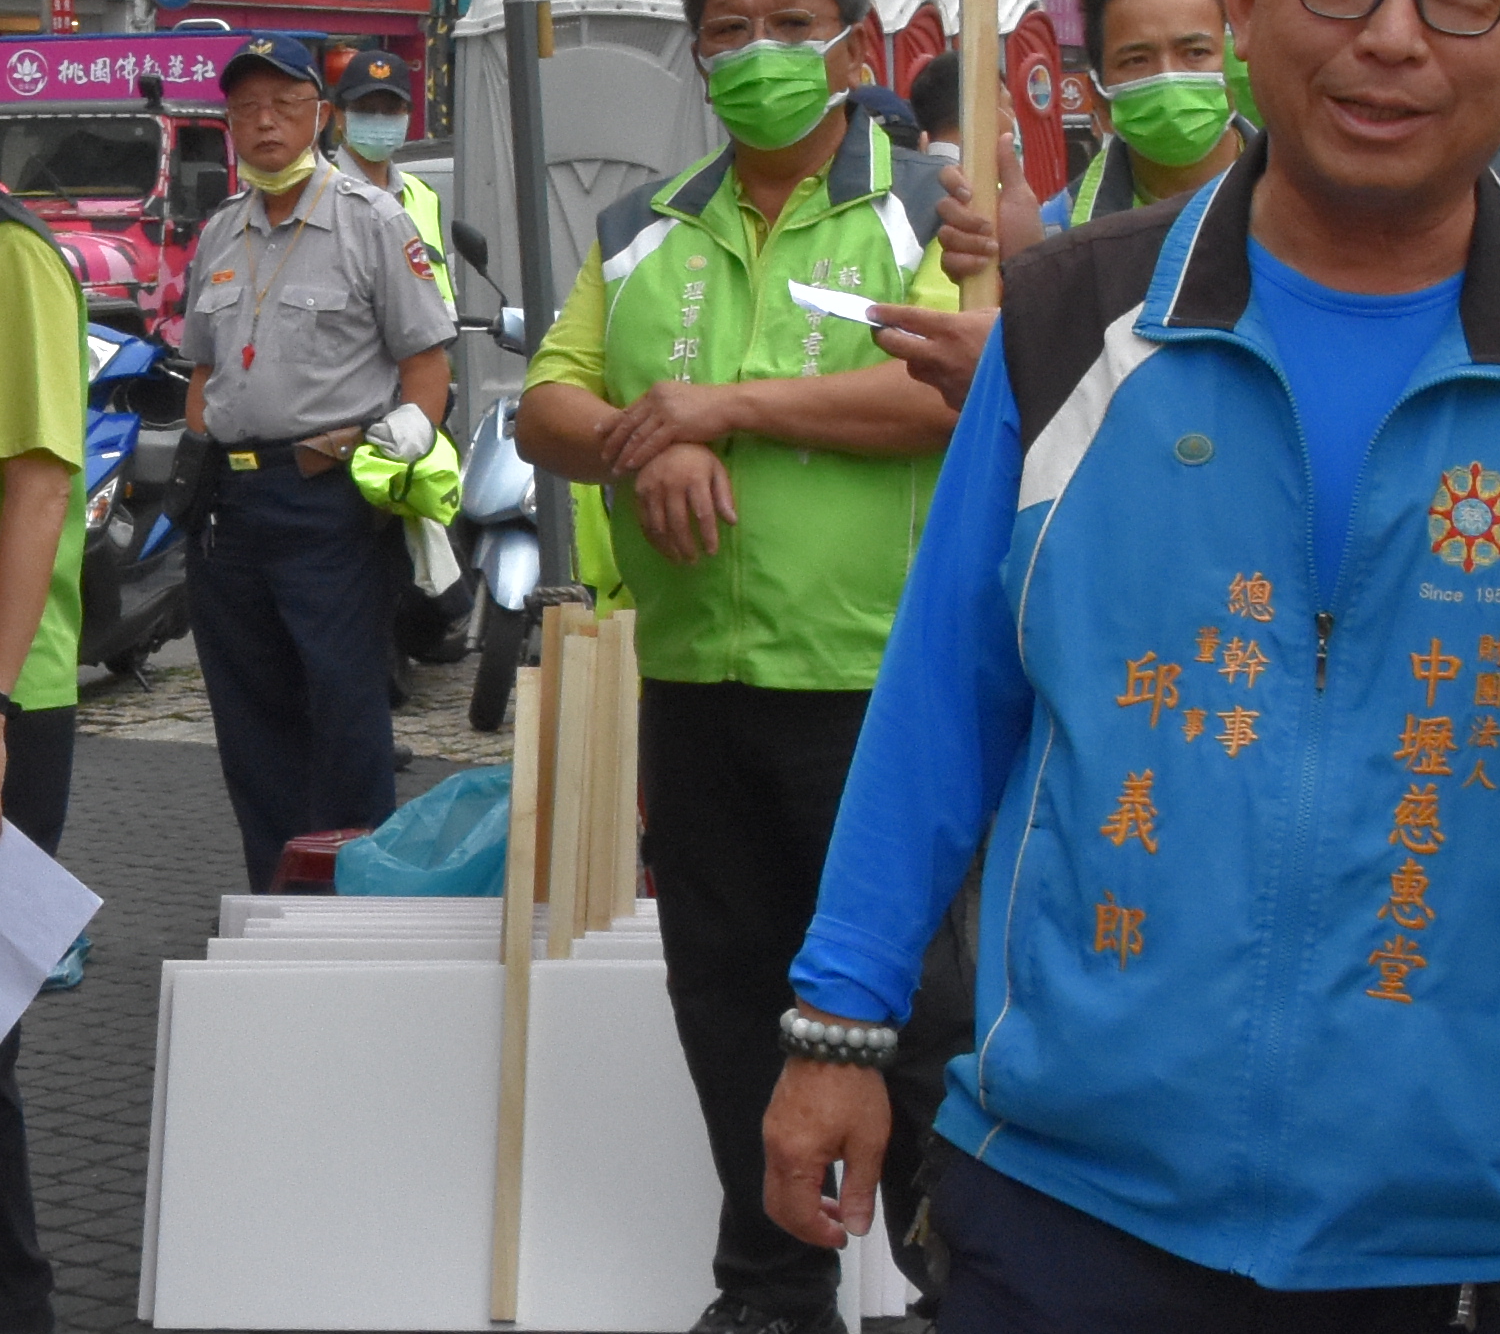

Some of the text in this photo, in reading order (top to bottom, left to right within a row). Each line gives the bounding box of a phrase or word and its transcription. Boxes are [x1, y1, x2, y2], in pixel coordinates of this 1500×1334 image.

[1214, 571, 1276, 758] 總幹事
[1419, 582, 1464, 603] Since
[1092, 650, 1181, 971] 邱義郎
[1366, 637, 1464, 1005] 中壢慈惠堂
